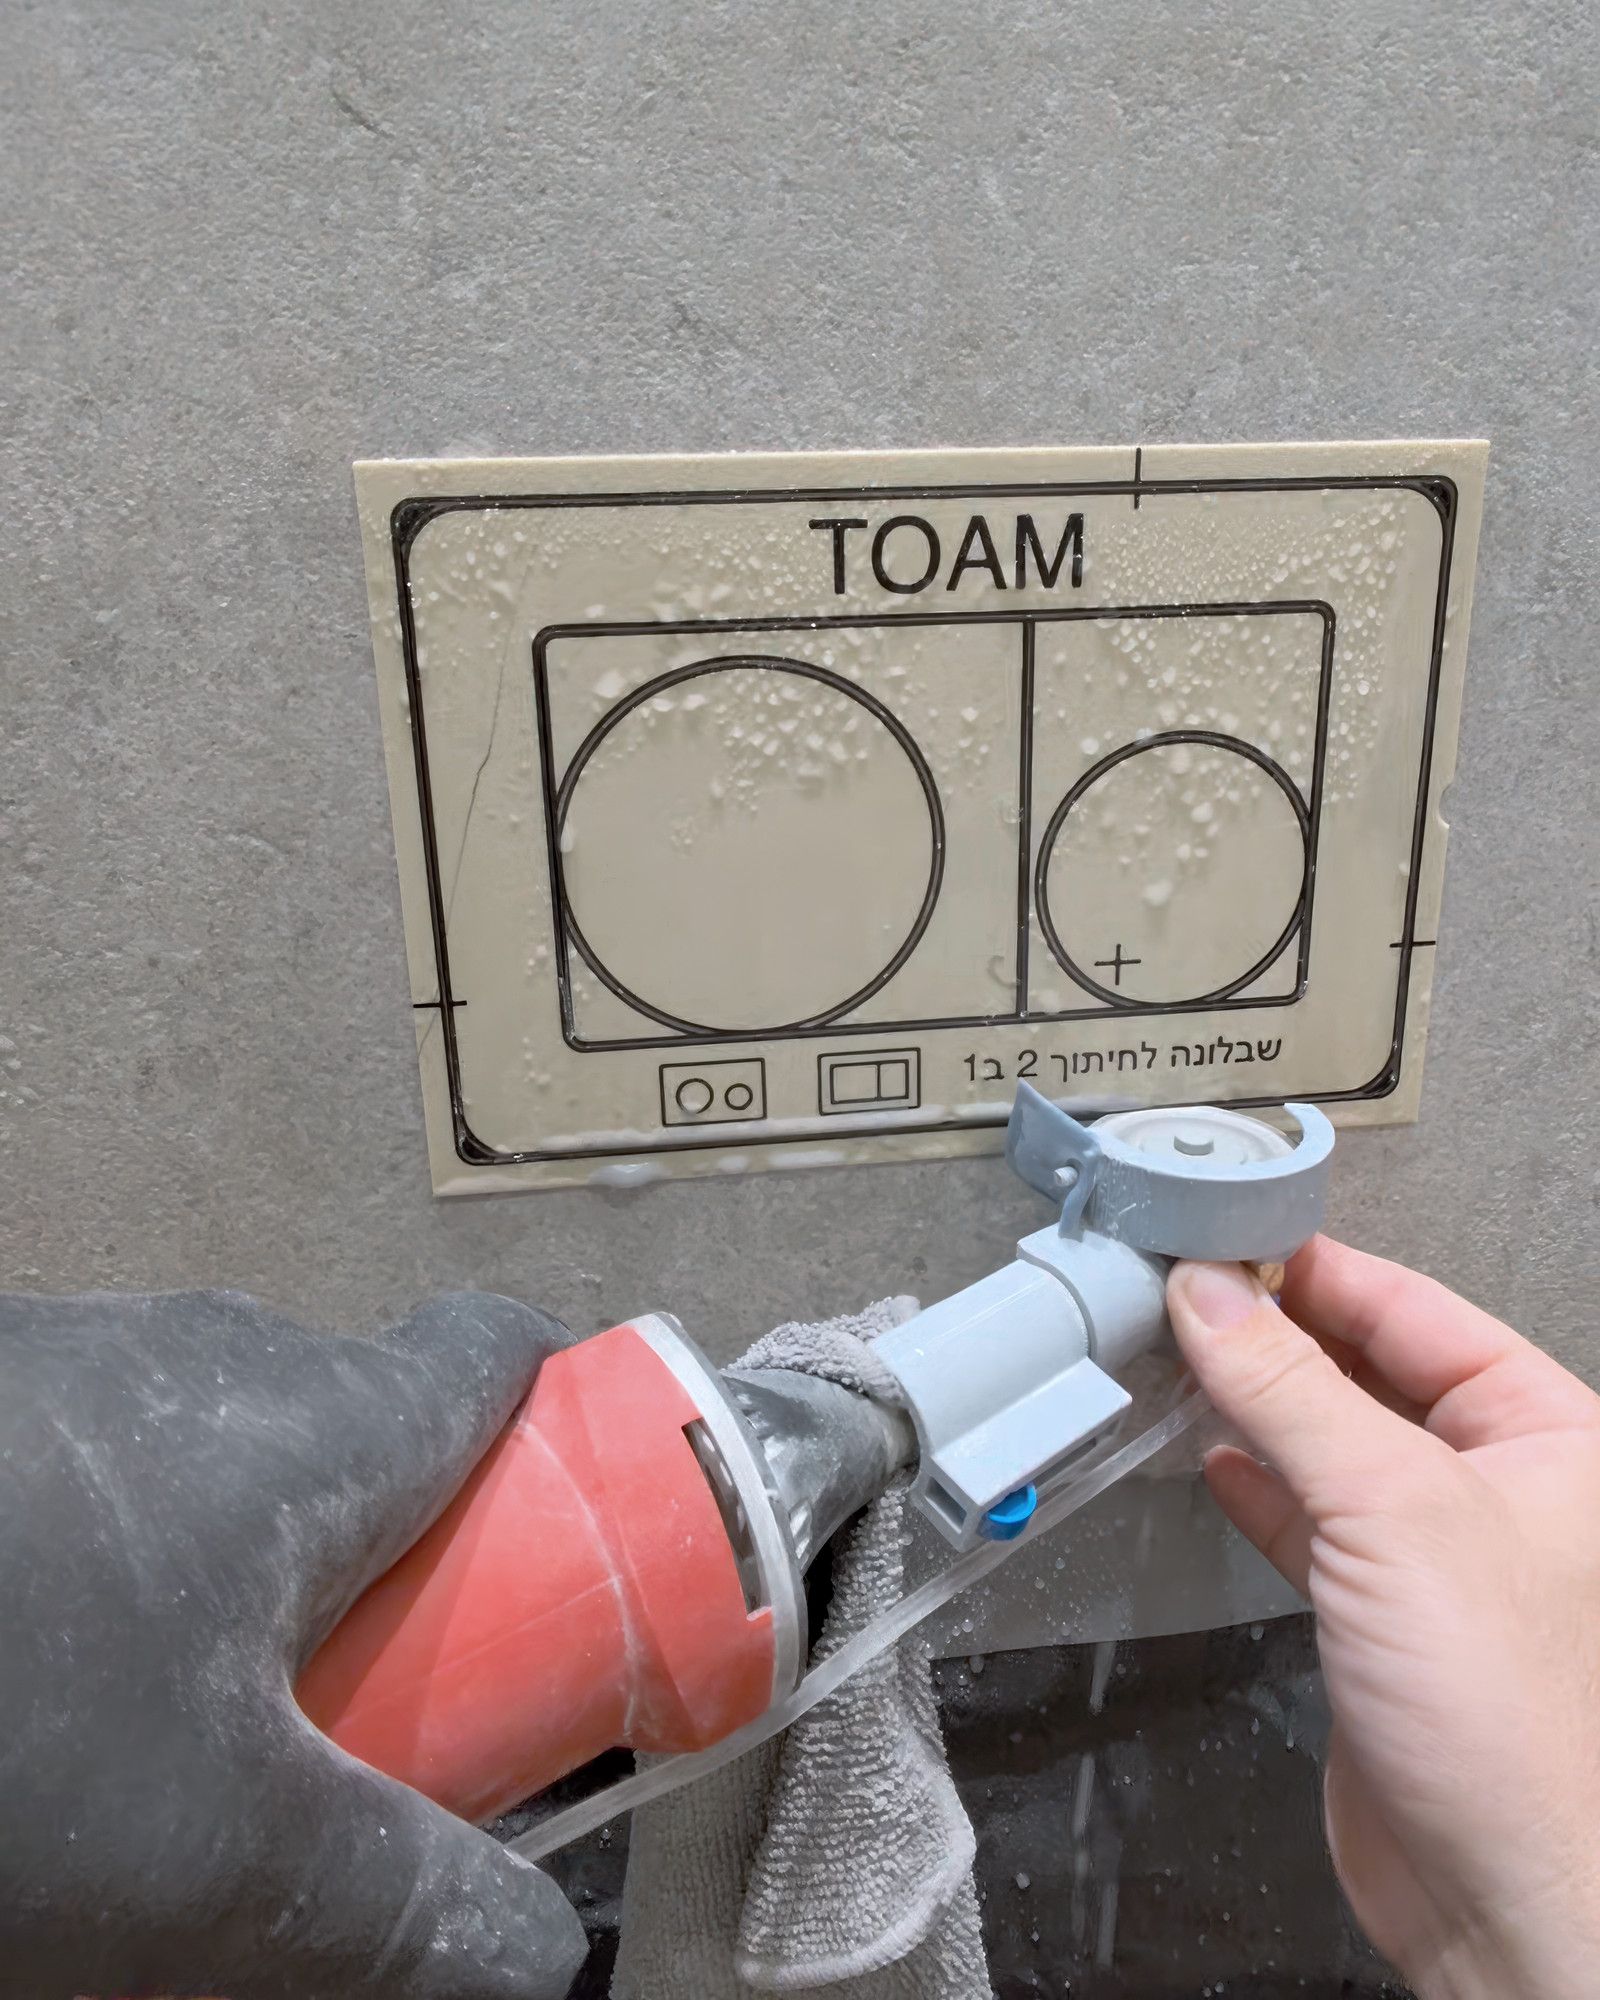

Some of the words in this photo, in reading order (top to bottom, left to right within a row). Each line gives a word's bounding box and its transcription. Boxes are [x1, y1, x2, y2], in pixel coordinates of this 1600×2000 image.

[808, 513, 1084, 595] TOAM
[1016, 1049, 1039, 1078] 2
[1050, 1041, 1158, 1083] לחיתוך
[1170, 1036, 1282, 1067] שבלונה
